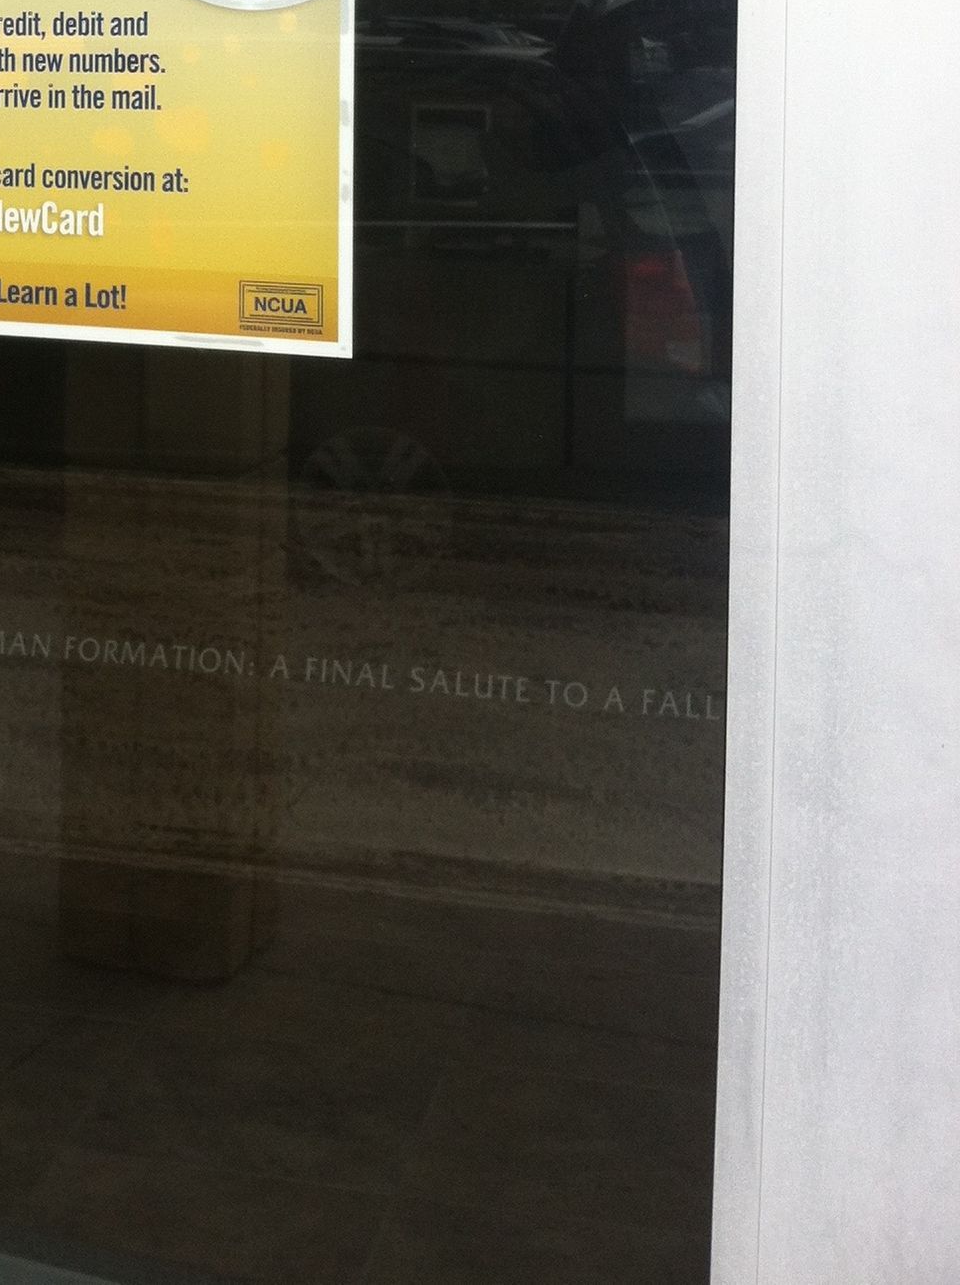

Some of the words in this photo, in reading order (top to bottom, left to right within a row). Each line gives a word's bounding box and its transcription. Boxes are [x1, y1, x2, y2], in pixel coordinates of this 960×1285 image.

[52, 11, 104, 37] debit
[109, 11, 148, 37] and
[22, 53, 63, 73] new
[69, 48, 166, 74] numbers.
[48, 83, 66, 109] in
[71, 84, 105, 110] the
[111, 84, 162, 111] mail.
[42, 166, 155, 192] conversion
[161, 168, 189, 193] at:
[64, 287, 79, 307] a
[84, 281, 127, 310] Lot!
[254, 296, 307, 314] NCUA
[63, 635, 256, 676] FORMATION:
[269, 654, 290, 680] A
[305, 657, 394, 690] FINAL
[409, 666, 531, 704] SALUTE
[544, 680, 588, 707] TO
[603, 686, 625, 712] A
